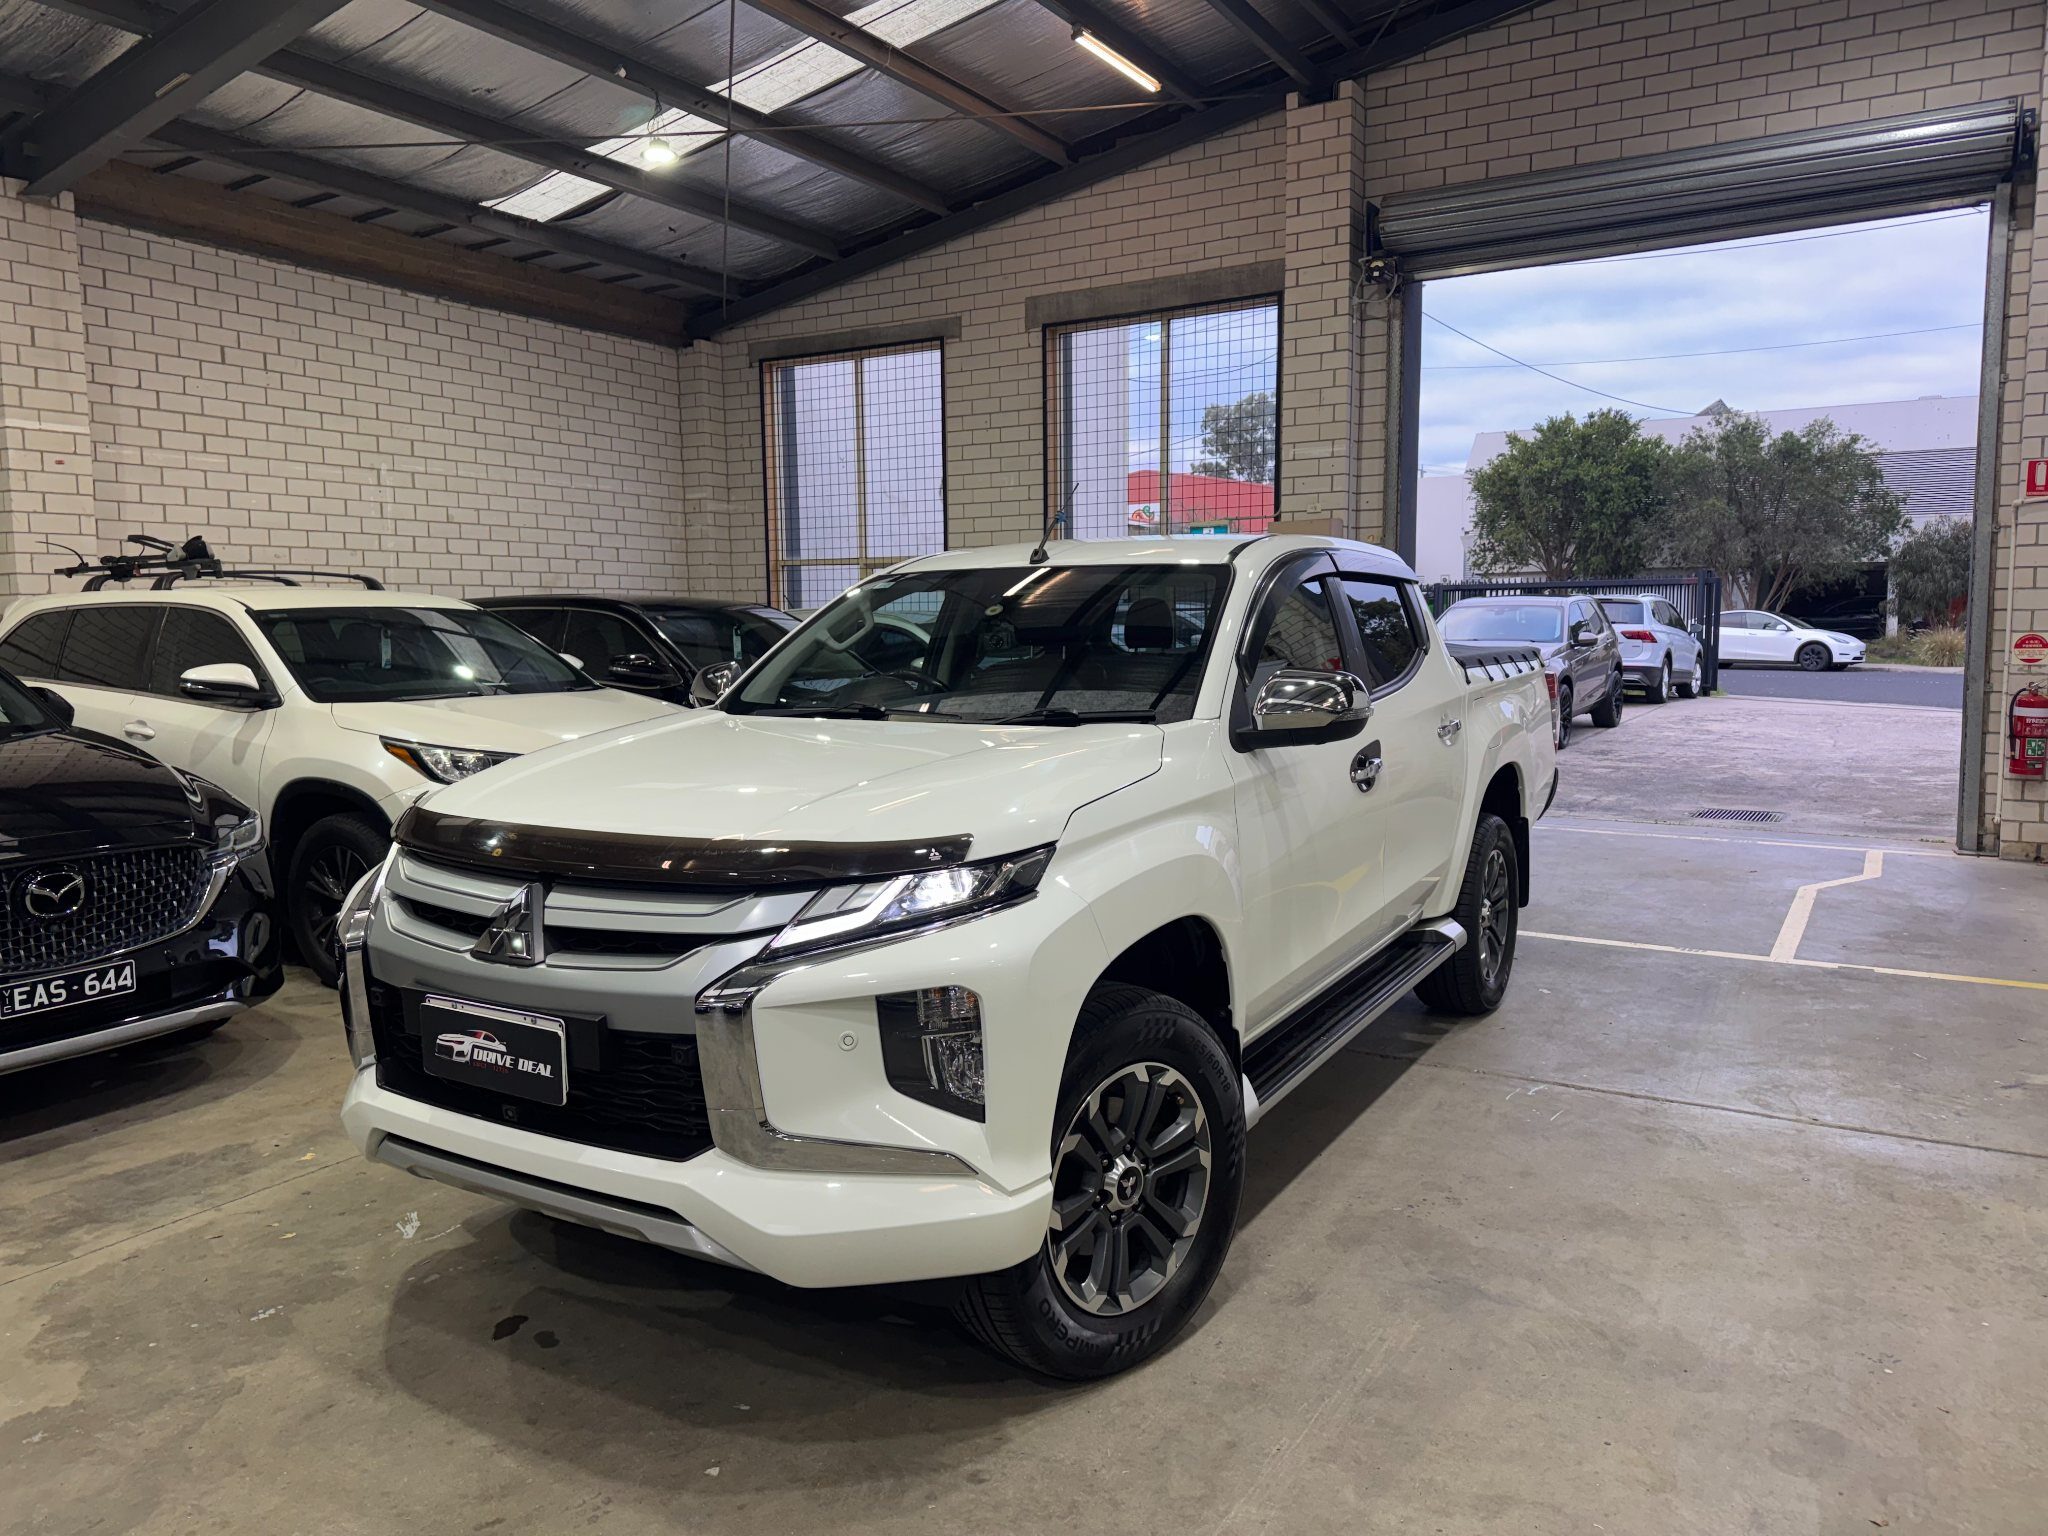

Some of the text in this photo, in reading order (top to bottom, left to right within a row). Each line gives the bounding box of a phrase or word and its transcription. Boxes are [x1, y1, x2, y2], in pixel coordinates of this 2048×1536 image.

[3, 990, 12, 1012] VIC
[473, 1048, 515, 1068] DRIVE
[518, 1058, 554, 1078] DEAL
